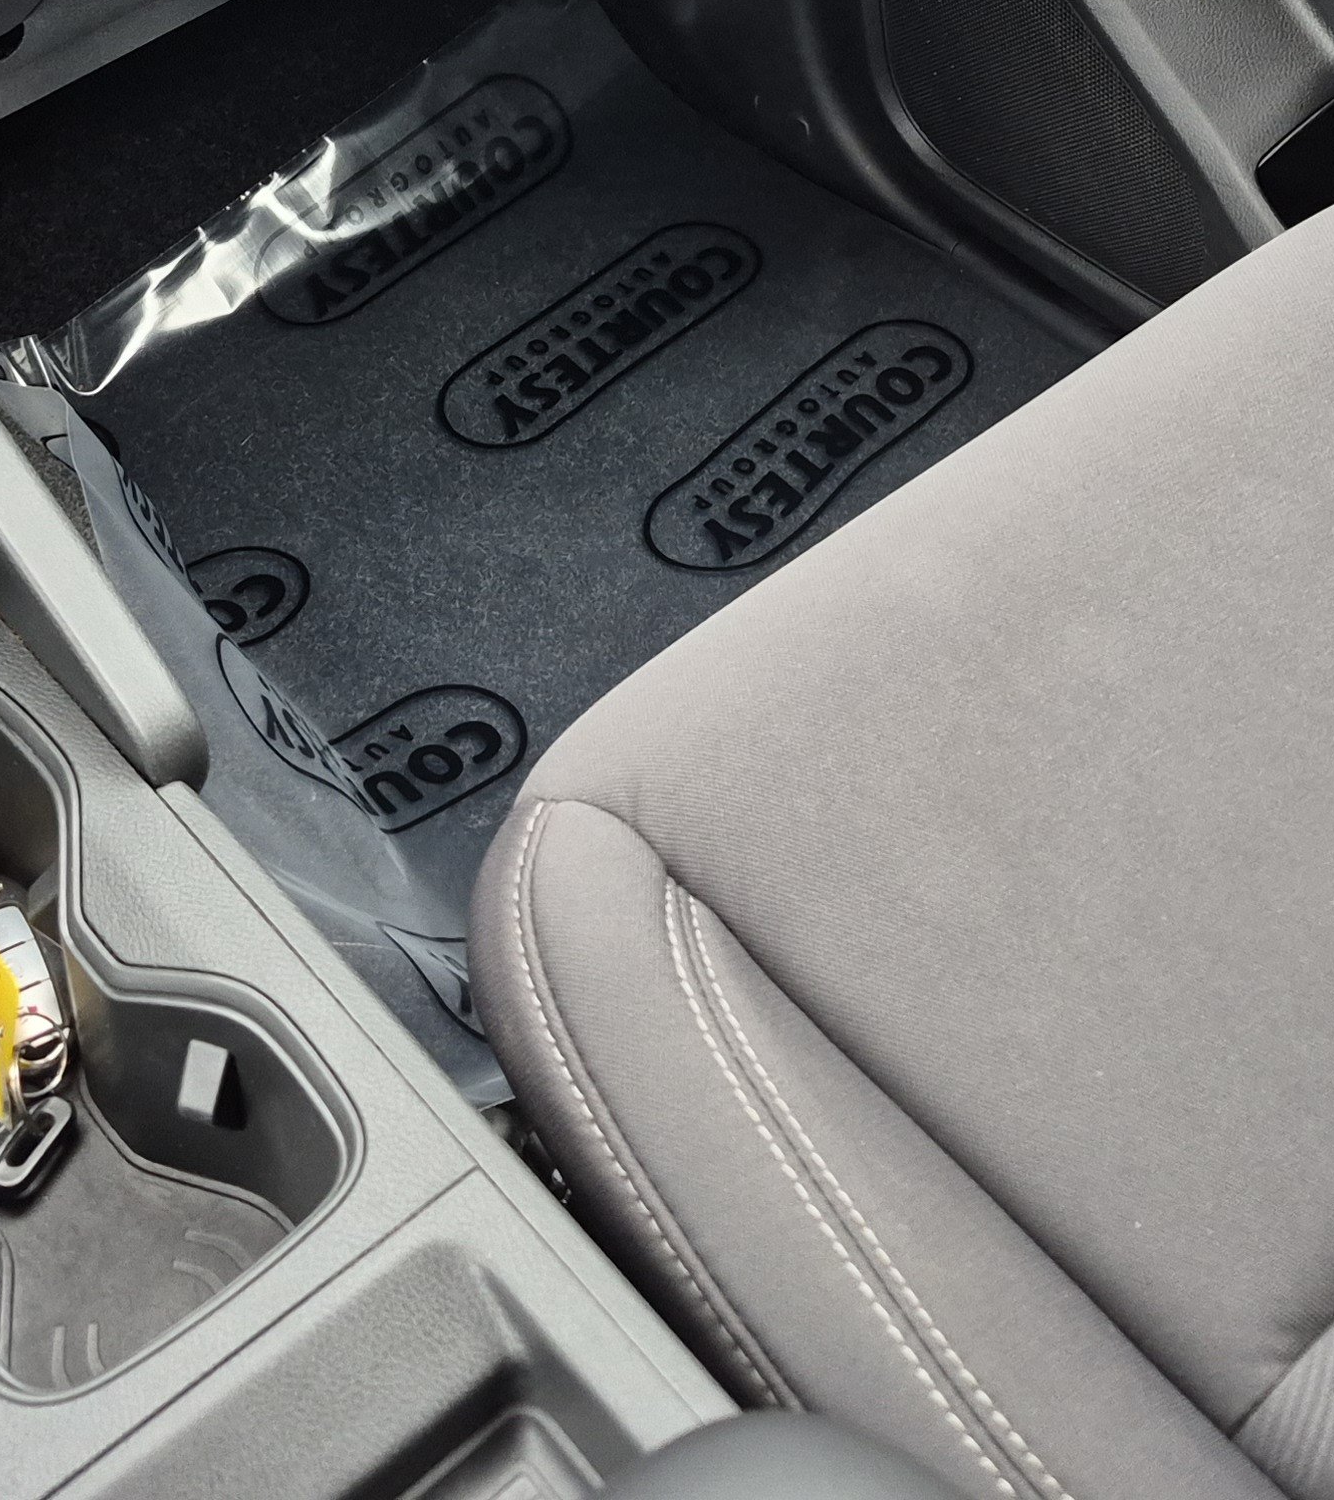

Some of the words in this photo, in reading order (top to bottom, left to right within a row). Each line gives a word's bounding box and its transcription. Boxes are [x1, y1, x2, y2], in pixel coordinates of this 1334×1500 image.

[307, 115, 554, 319] COURTESY
[495, 247, 743, 438] COURTESY
[703, 345, 953, 563] COURTESY
